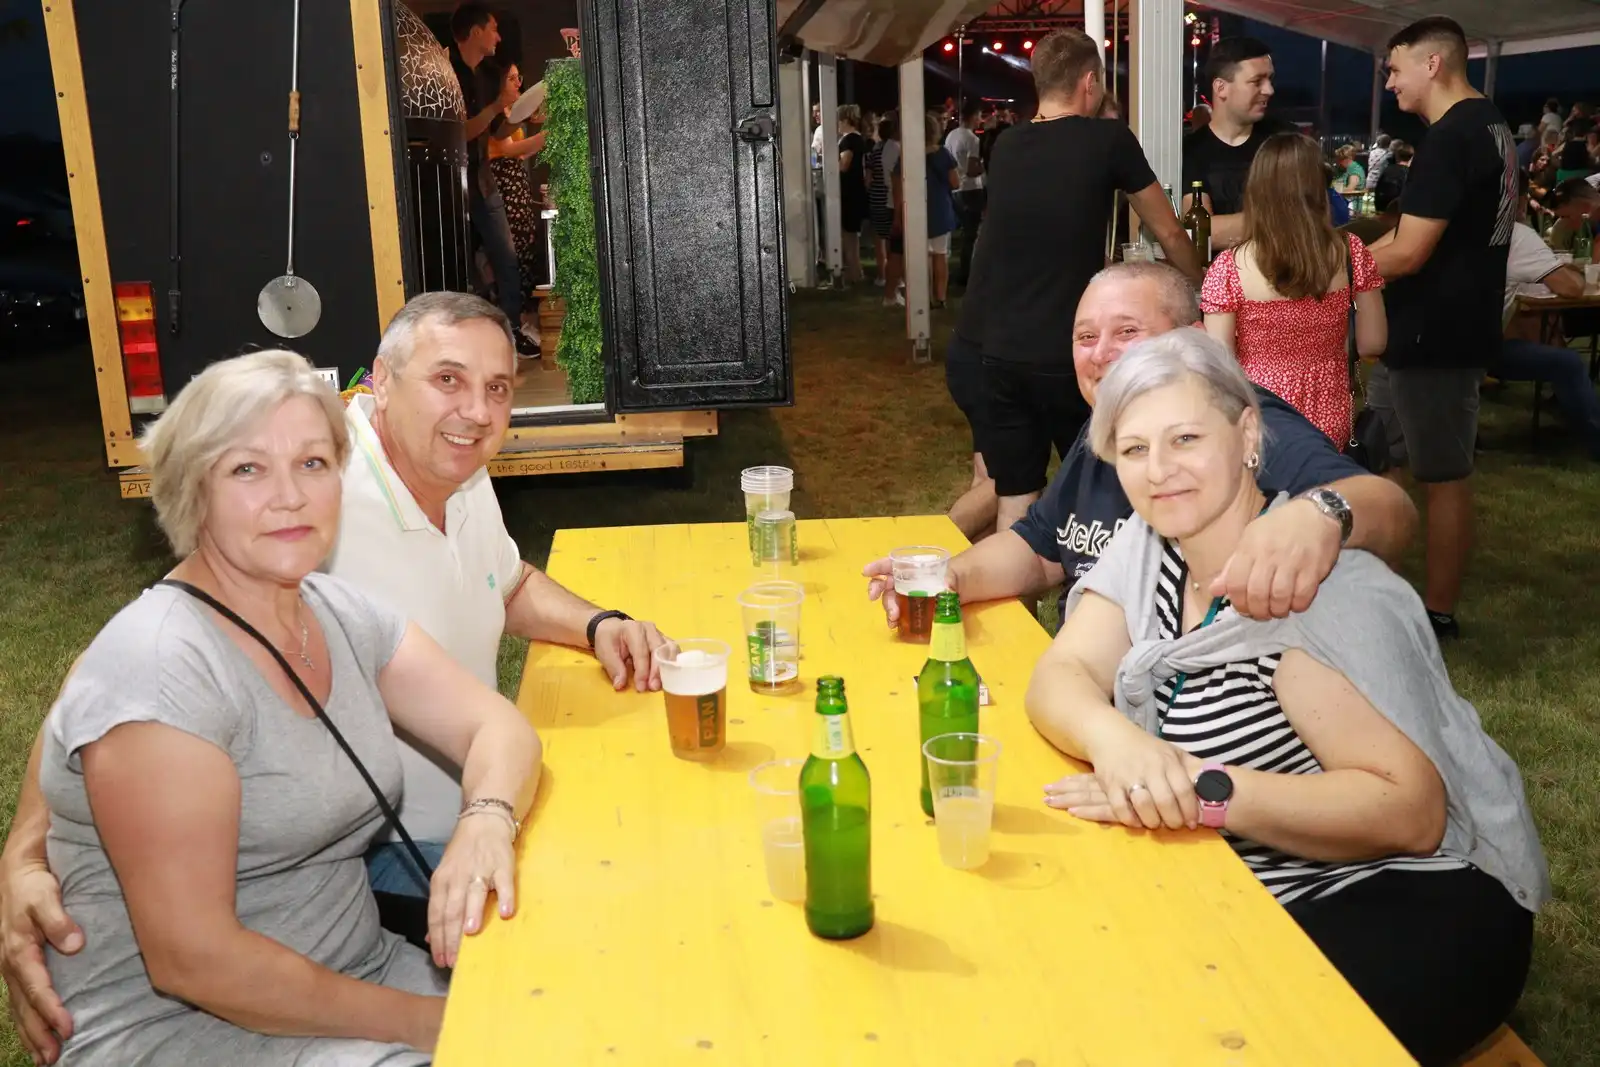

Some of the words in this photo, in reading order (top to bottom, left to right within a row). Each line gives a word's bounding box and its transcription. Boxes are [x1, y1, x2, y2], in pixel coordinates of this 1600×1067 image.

[497, 463, 514, 473] the
[519, 460, 553, 475] good
[750, 642, 761, 677] PAN
[701, 700, 715, 741] PAN
